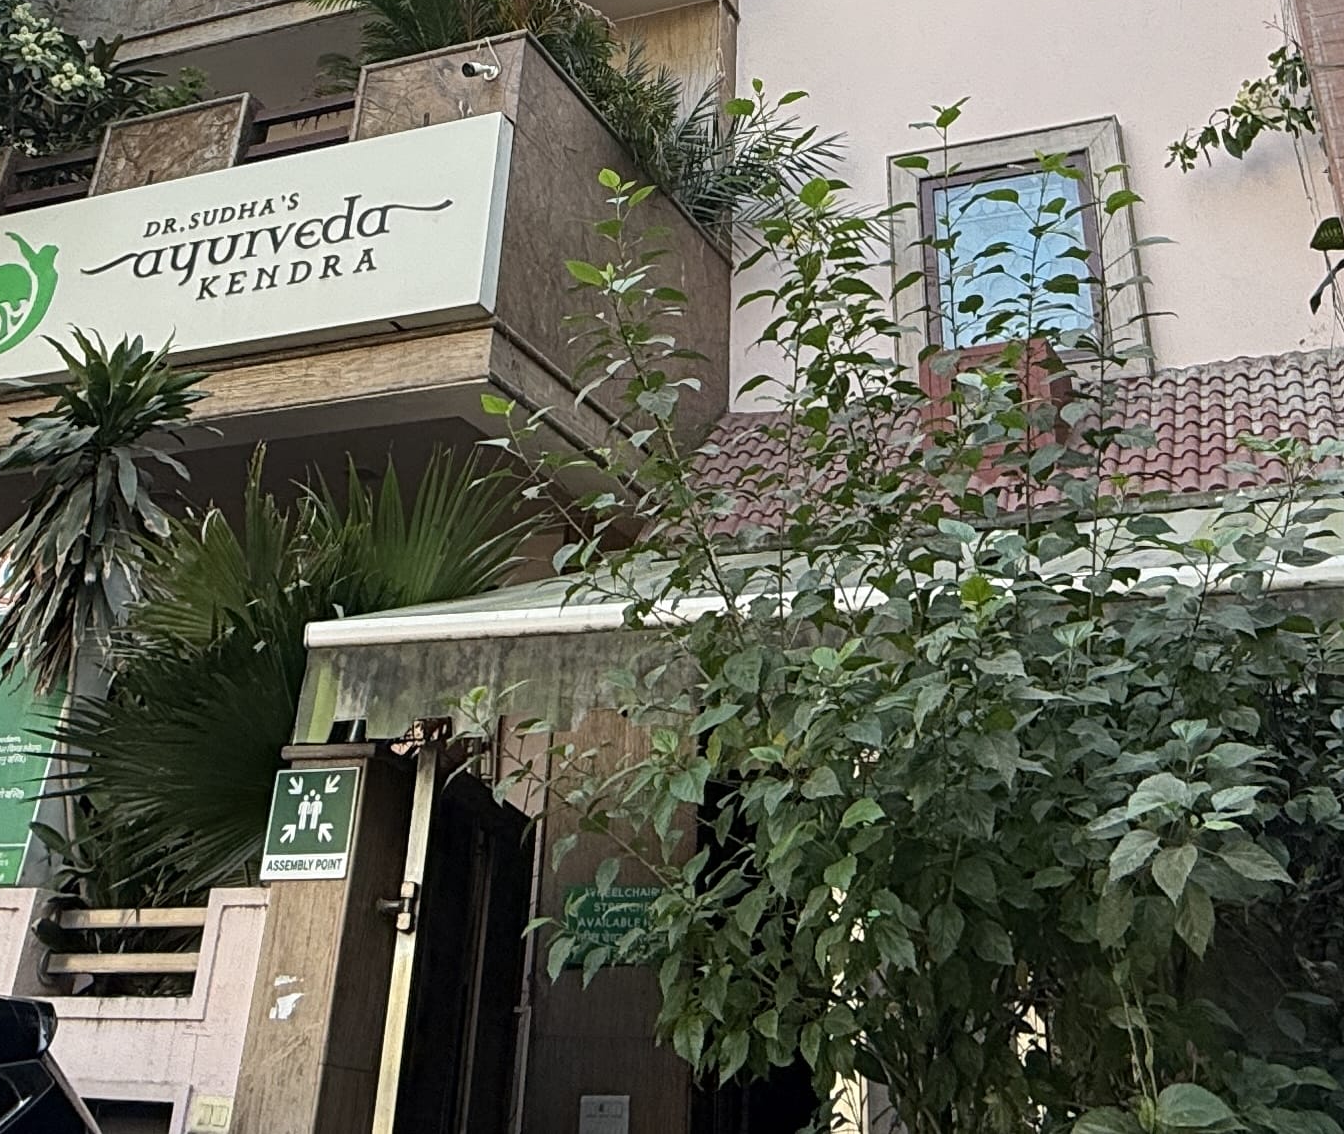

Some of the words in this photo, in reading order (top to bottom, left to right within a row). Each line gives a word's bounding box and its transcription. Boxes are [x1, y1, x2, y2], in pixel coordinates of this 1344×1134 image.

[81, 194, 453, 287] ayurveda
[195, 247, 377, 301] KENDRA
[266, 859, 315, 872] ASSEMBLY
[315, 857, 343, 871] POINT
